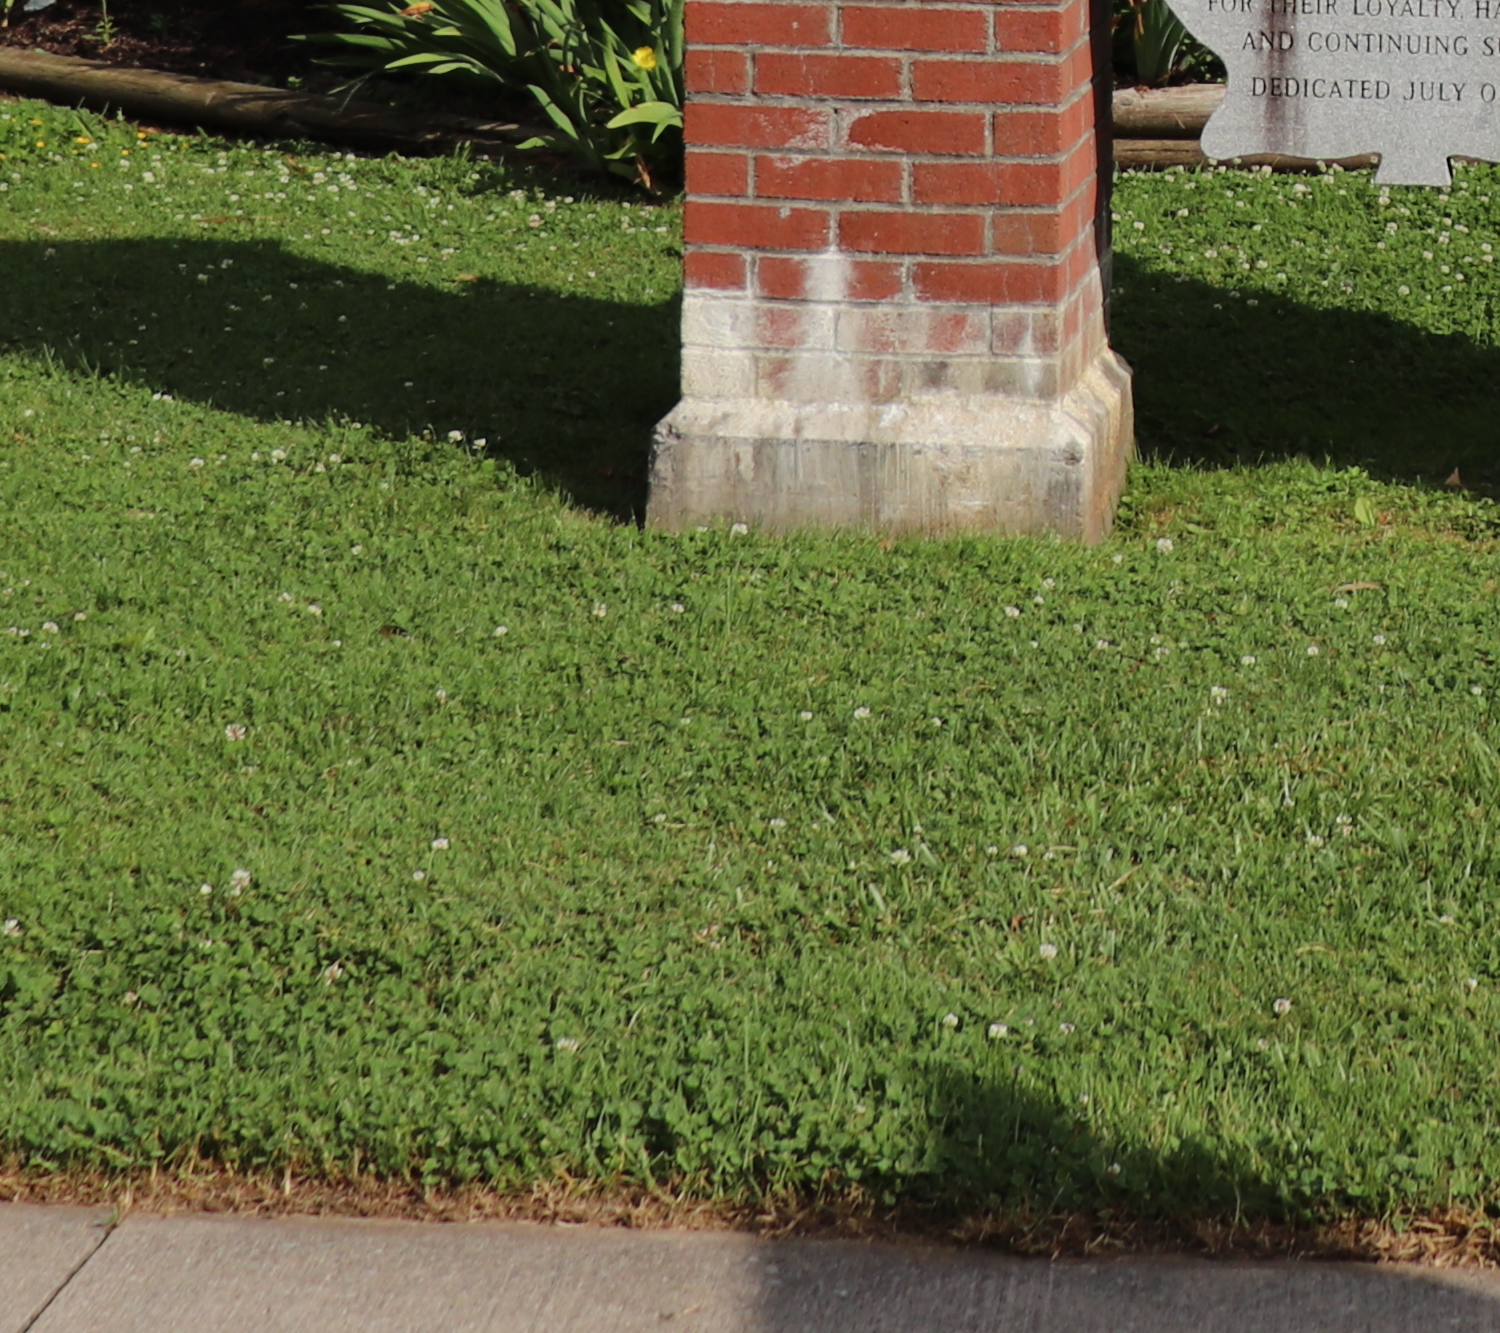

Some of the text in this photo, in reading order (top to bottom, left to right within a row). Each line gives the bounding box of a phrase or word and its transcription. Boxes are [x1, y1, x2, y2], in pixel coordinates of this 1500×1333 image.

[1241, 31, 1294, 52] AND
[1308, 32, 1468, 56] CONTINUING
[1252, 76, 1390, 101] DEDICATED
[1403, 81, 1465, 102] JULY
